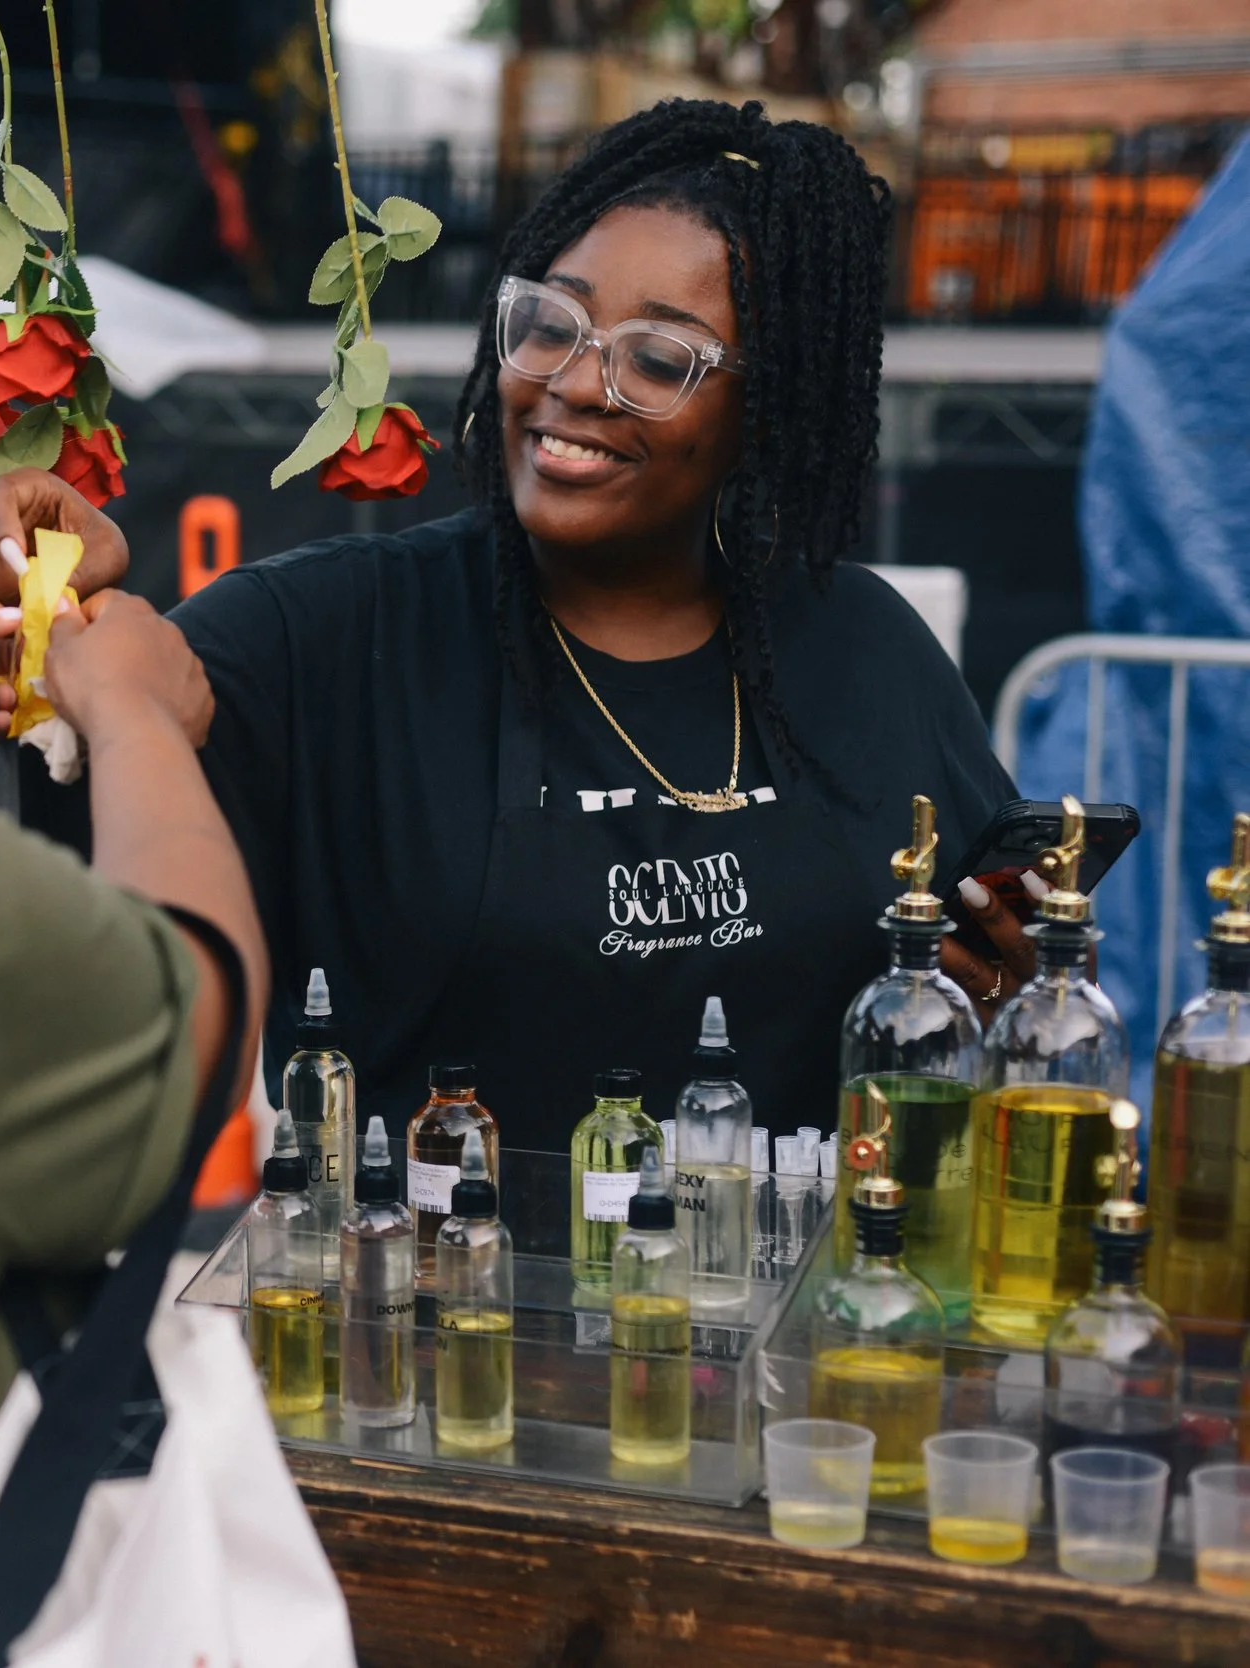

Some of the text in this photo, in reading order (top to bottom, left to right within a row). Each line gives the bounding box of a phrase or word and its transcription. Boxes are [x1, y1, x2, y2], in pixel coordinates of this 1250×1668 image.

[608, 876, 746, 900] SOUL LANGUAGE
[599, 917, 764, 959] Fragrance Bar
[305, 1154, 339, 1183] CE
